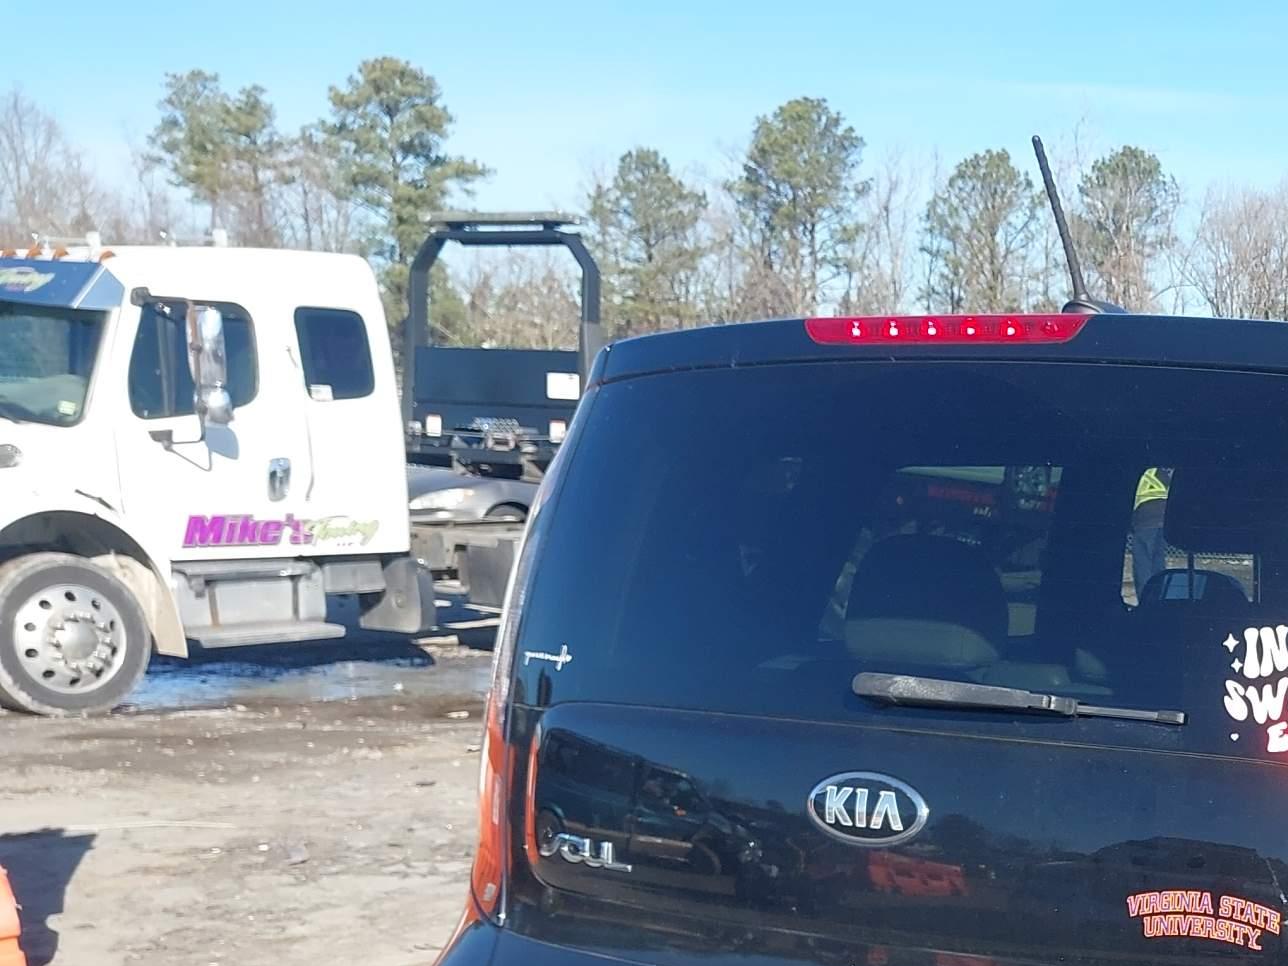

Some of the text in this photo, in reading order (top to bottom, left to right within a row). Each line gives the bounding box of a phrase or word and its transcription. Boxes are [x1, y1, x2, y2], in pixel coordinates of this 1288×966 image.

[182, 513, 315, 548] Mike's
[825, 785, 904, 831] KIA
[1126, 890, 1281, 936] VIRGINIA STATE
